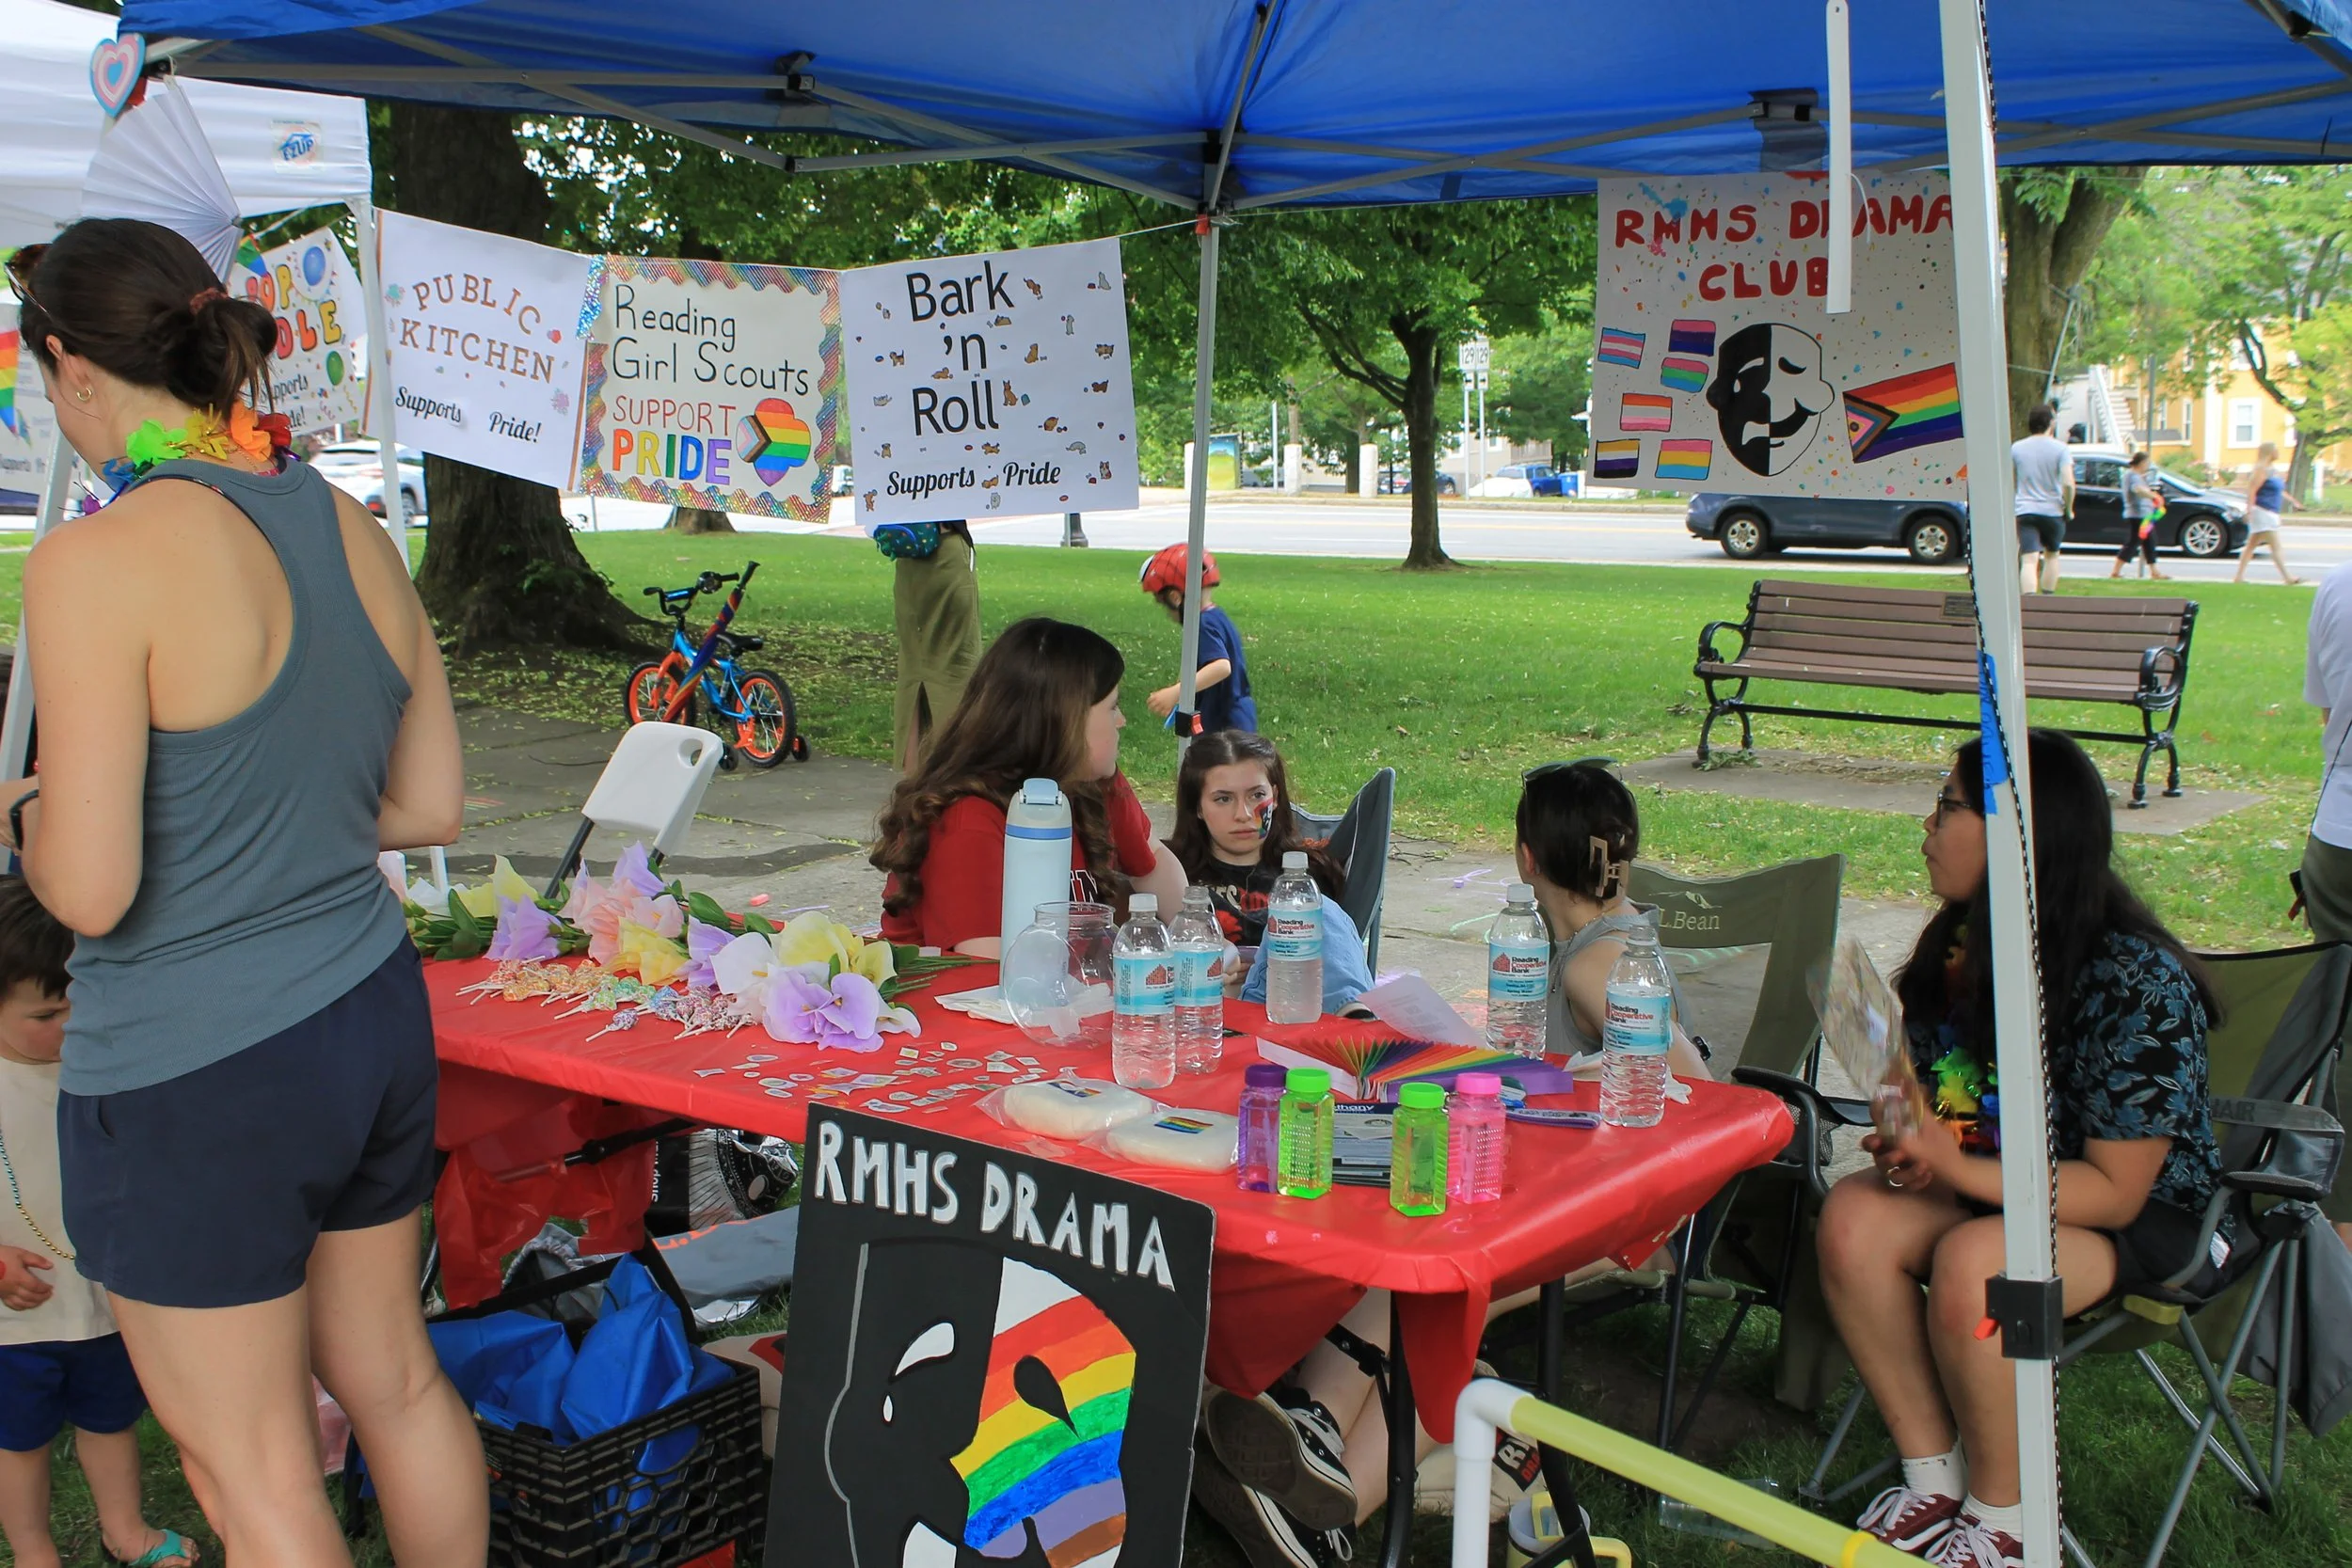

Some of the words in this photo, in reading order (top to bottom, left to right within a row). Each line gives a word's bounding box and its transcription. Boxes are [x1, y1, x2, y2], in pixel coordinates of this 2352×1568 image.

[1789, 193, 1955, 240] DAMA
[412, 273, 542, 335] PUBLIC
[906, 260, 1015, 322] Bark
[1698, 257, 1829, 301] CLUB
[616, 284, 736, 353] Reading
[399, 318, 555, 384] KITCHEN
[612, 337, 676, 383] Girl
[694, 341, 809, 396] Scouts
[1461, 346, 1474, 365] 129
[1476, 346, 1488, 364] 129
[395, 387, 462, 423] Supports
[488, 411, 542, 443] Pride!
[612, 395, 737, 436] SUPPORT
[912, 379, 1000, 436] Roll
[612, 428, 733, 485] PRIDE
[886, 467, 976, 500] Supports
[1003, 461, 1061, 486] Pride
[814, 1119, 960, 1225] RMHS
[980, 1161, 1176, 1292] DRAMA
